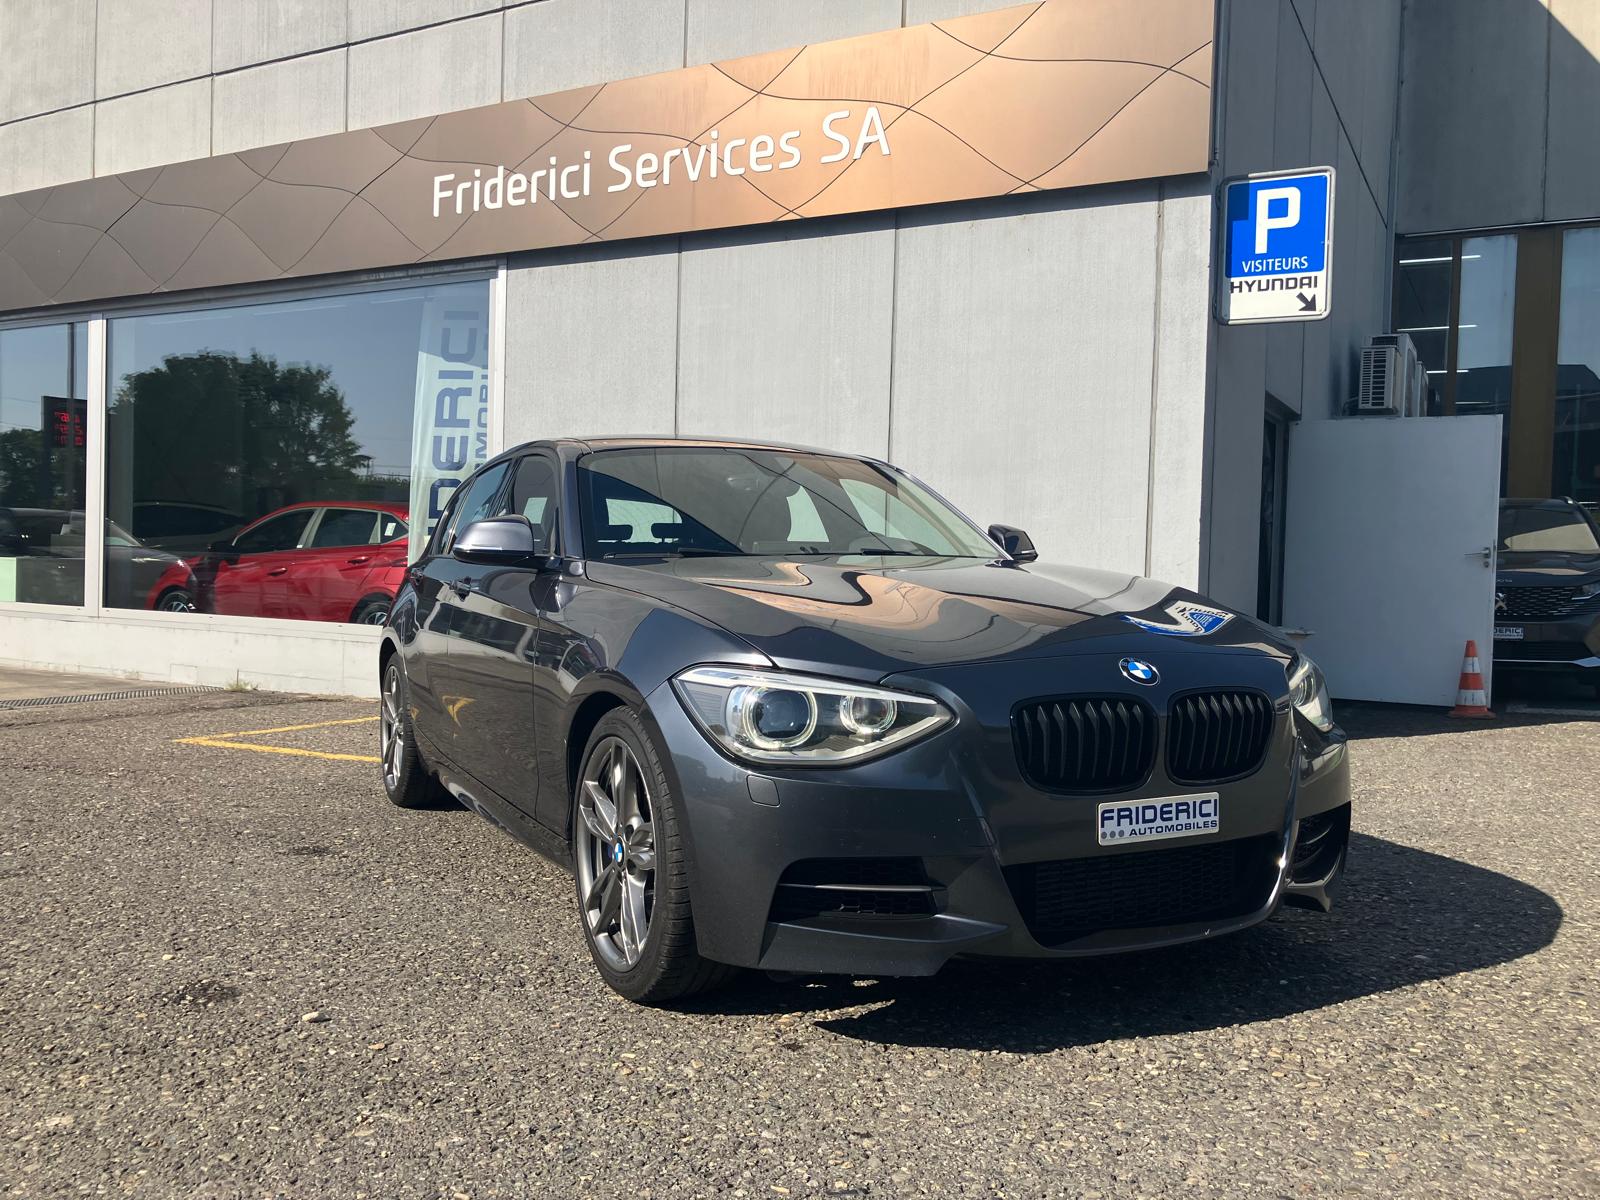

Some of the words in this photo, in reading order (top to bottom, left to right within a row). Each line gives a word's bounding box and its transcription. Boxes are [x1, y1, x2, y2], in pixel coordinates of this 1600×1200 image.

[433, 151, 591, 218] Friderici
[608, 130, 801, 193] Services
[820, 107, 892, 164] SA
[1255, 187, 1301, 254] P
[1242, 256, 1308, 273] VISITEURS
[1230, 276, 1318, 293] HYUNDAI
[428, 311, 479, 535] DERICI
[1101, 799, 1218, 828] FRIDERICI
[1129, 820, 1218, 836] AUTOMOBILES
